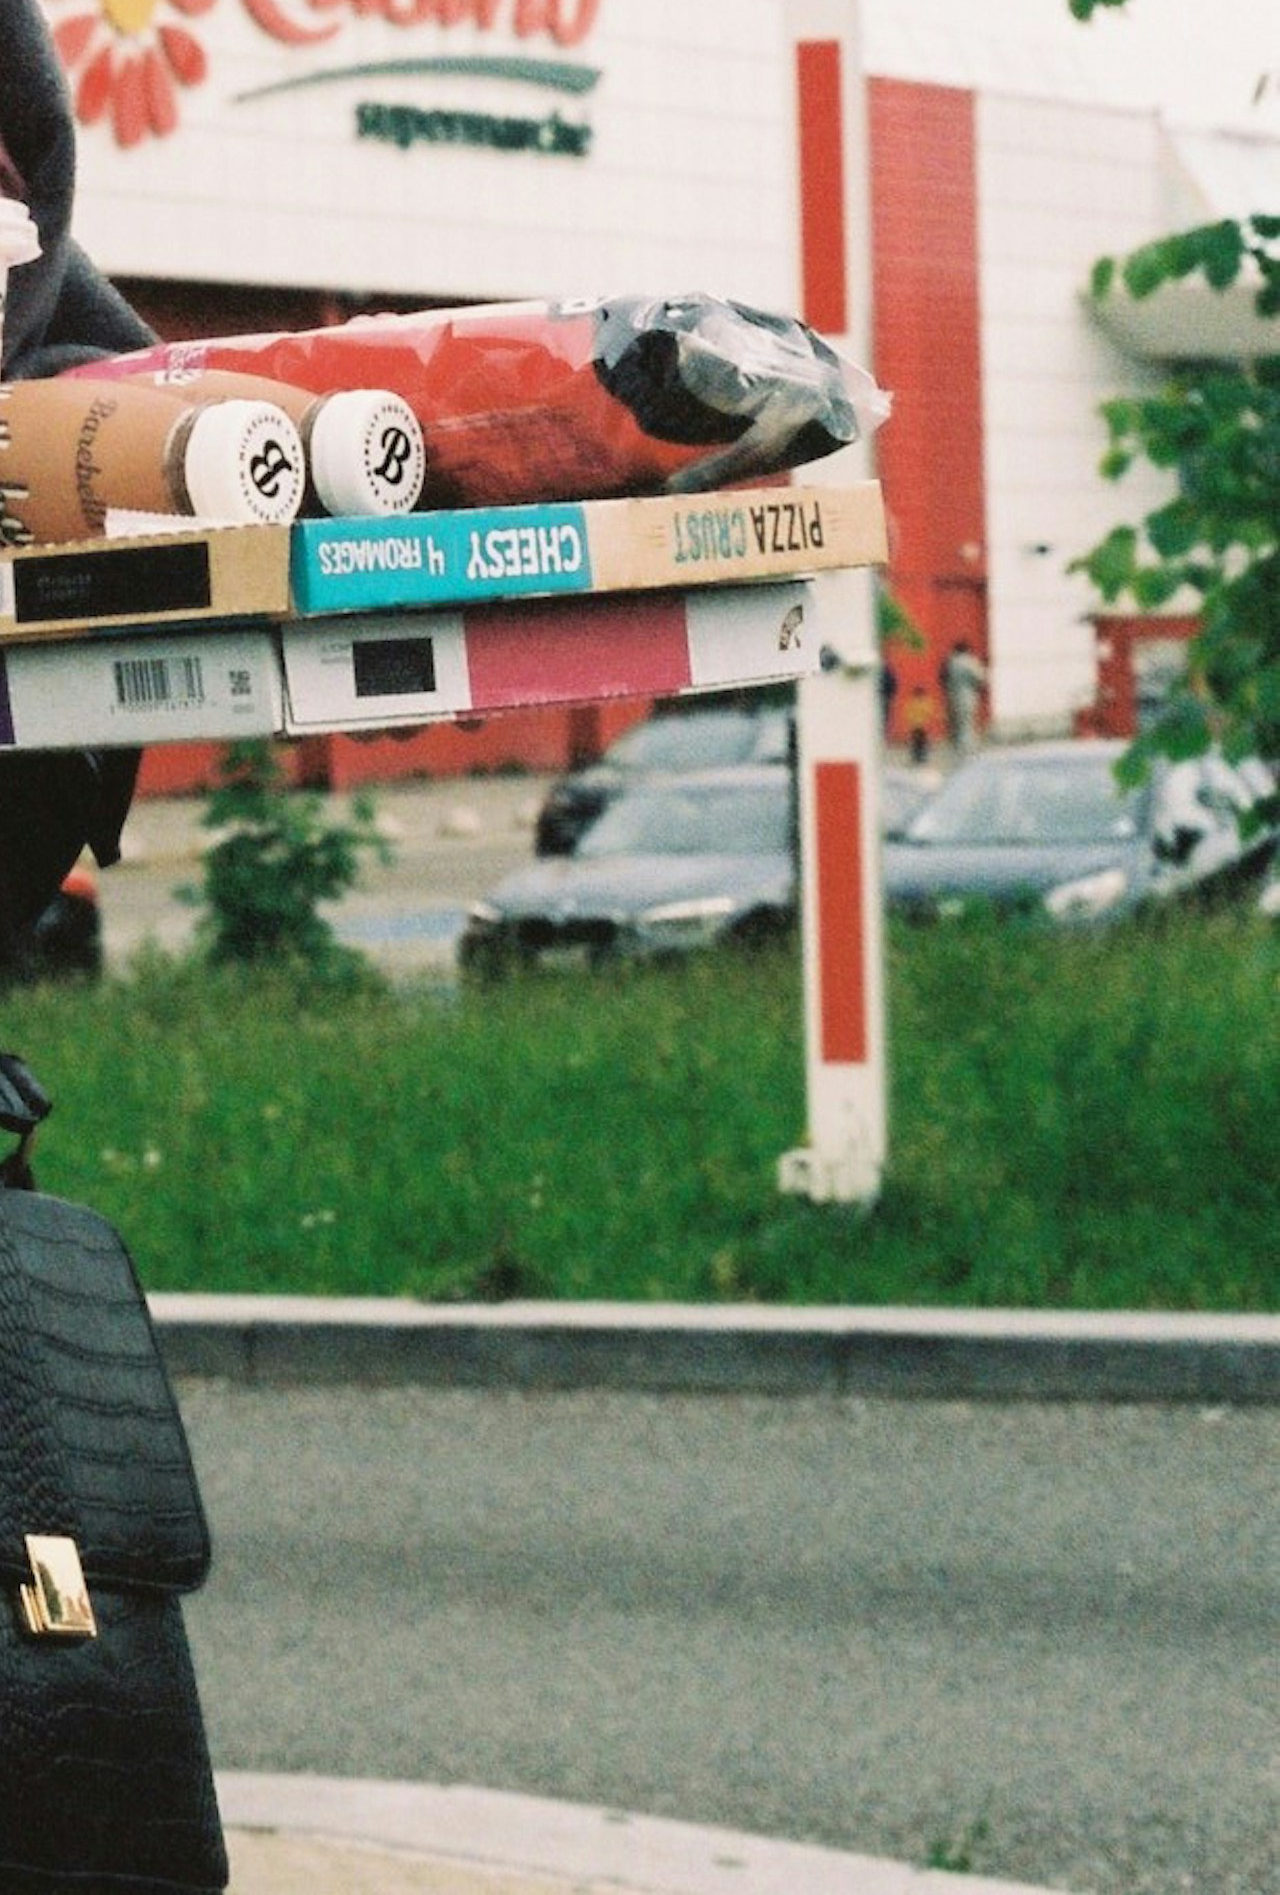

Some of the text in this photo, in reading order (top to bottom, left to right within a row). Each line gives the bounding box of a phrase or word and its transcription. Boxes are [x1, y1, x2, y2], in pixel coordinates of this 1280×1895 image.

[317, 535, 445, 576] 4 FROMAGES
[466, 525, 582, 580] CHEESY
[673, 501, 824, 565] PIZZA CRUST
